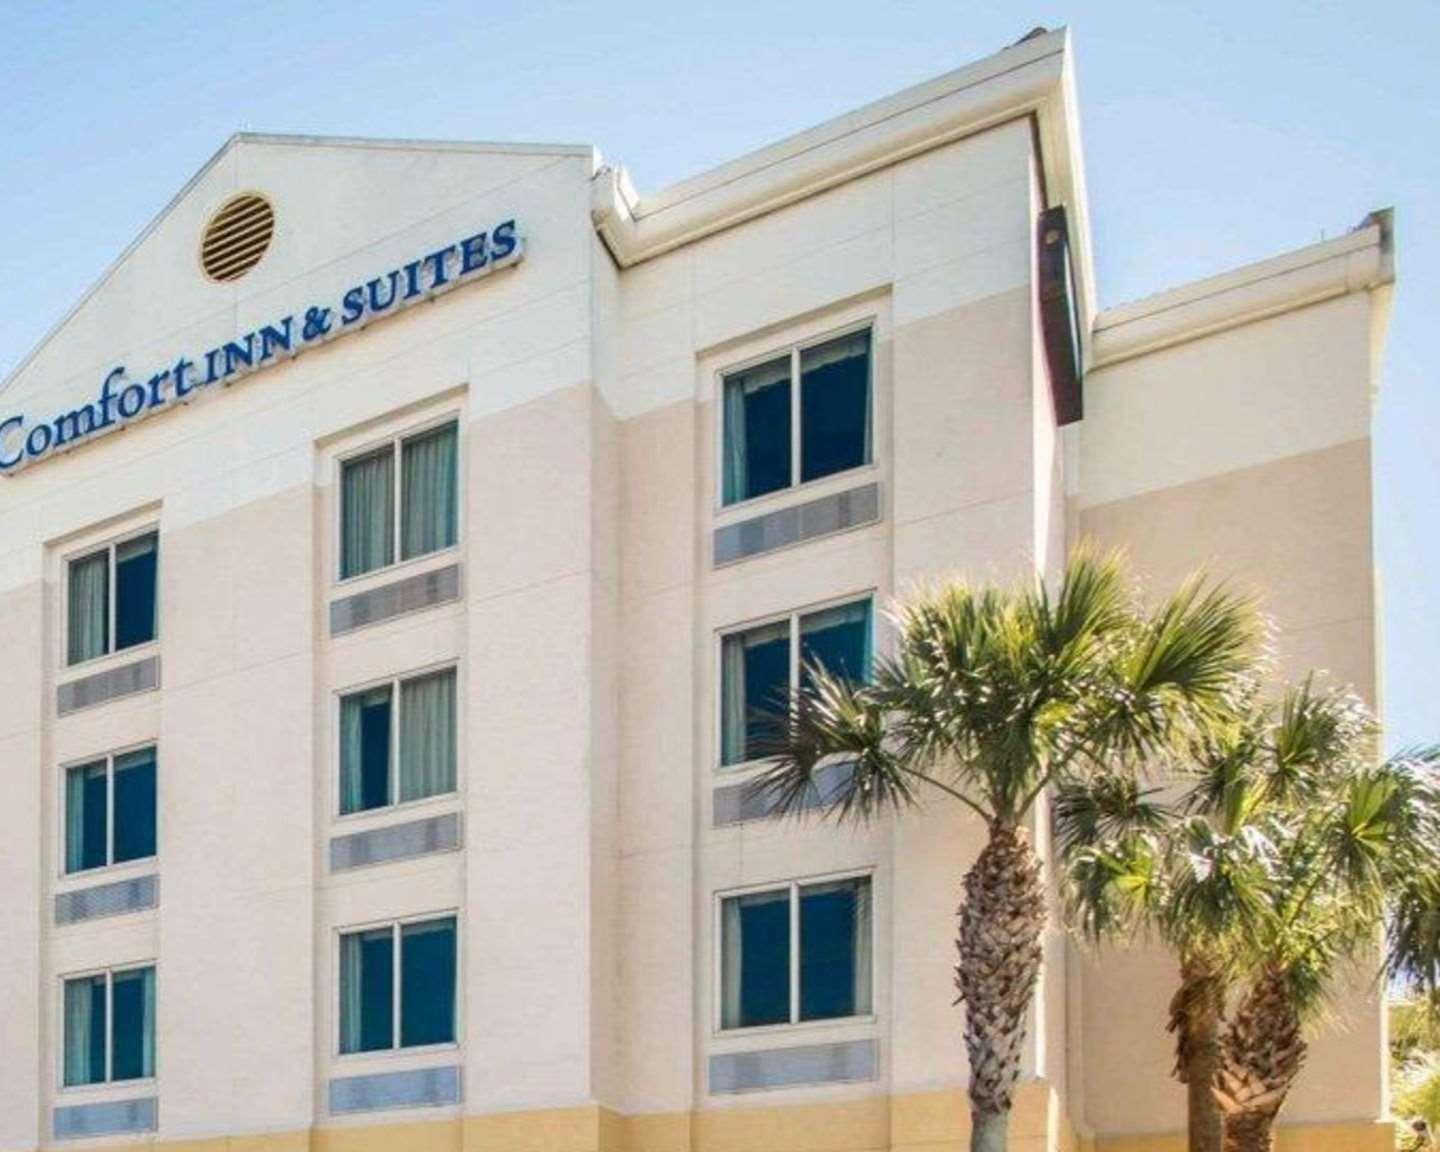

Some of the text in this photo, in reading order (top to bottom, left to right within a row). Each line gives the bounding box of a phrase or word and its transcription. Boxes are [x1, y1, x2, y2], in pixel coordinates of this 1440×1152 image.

[203, 316, 293, 387] INN
[300, 306, 331, 341] &
[342, 219, 518, 325] SUITES
